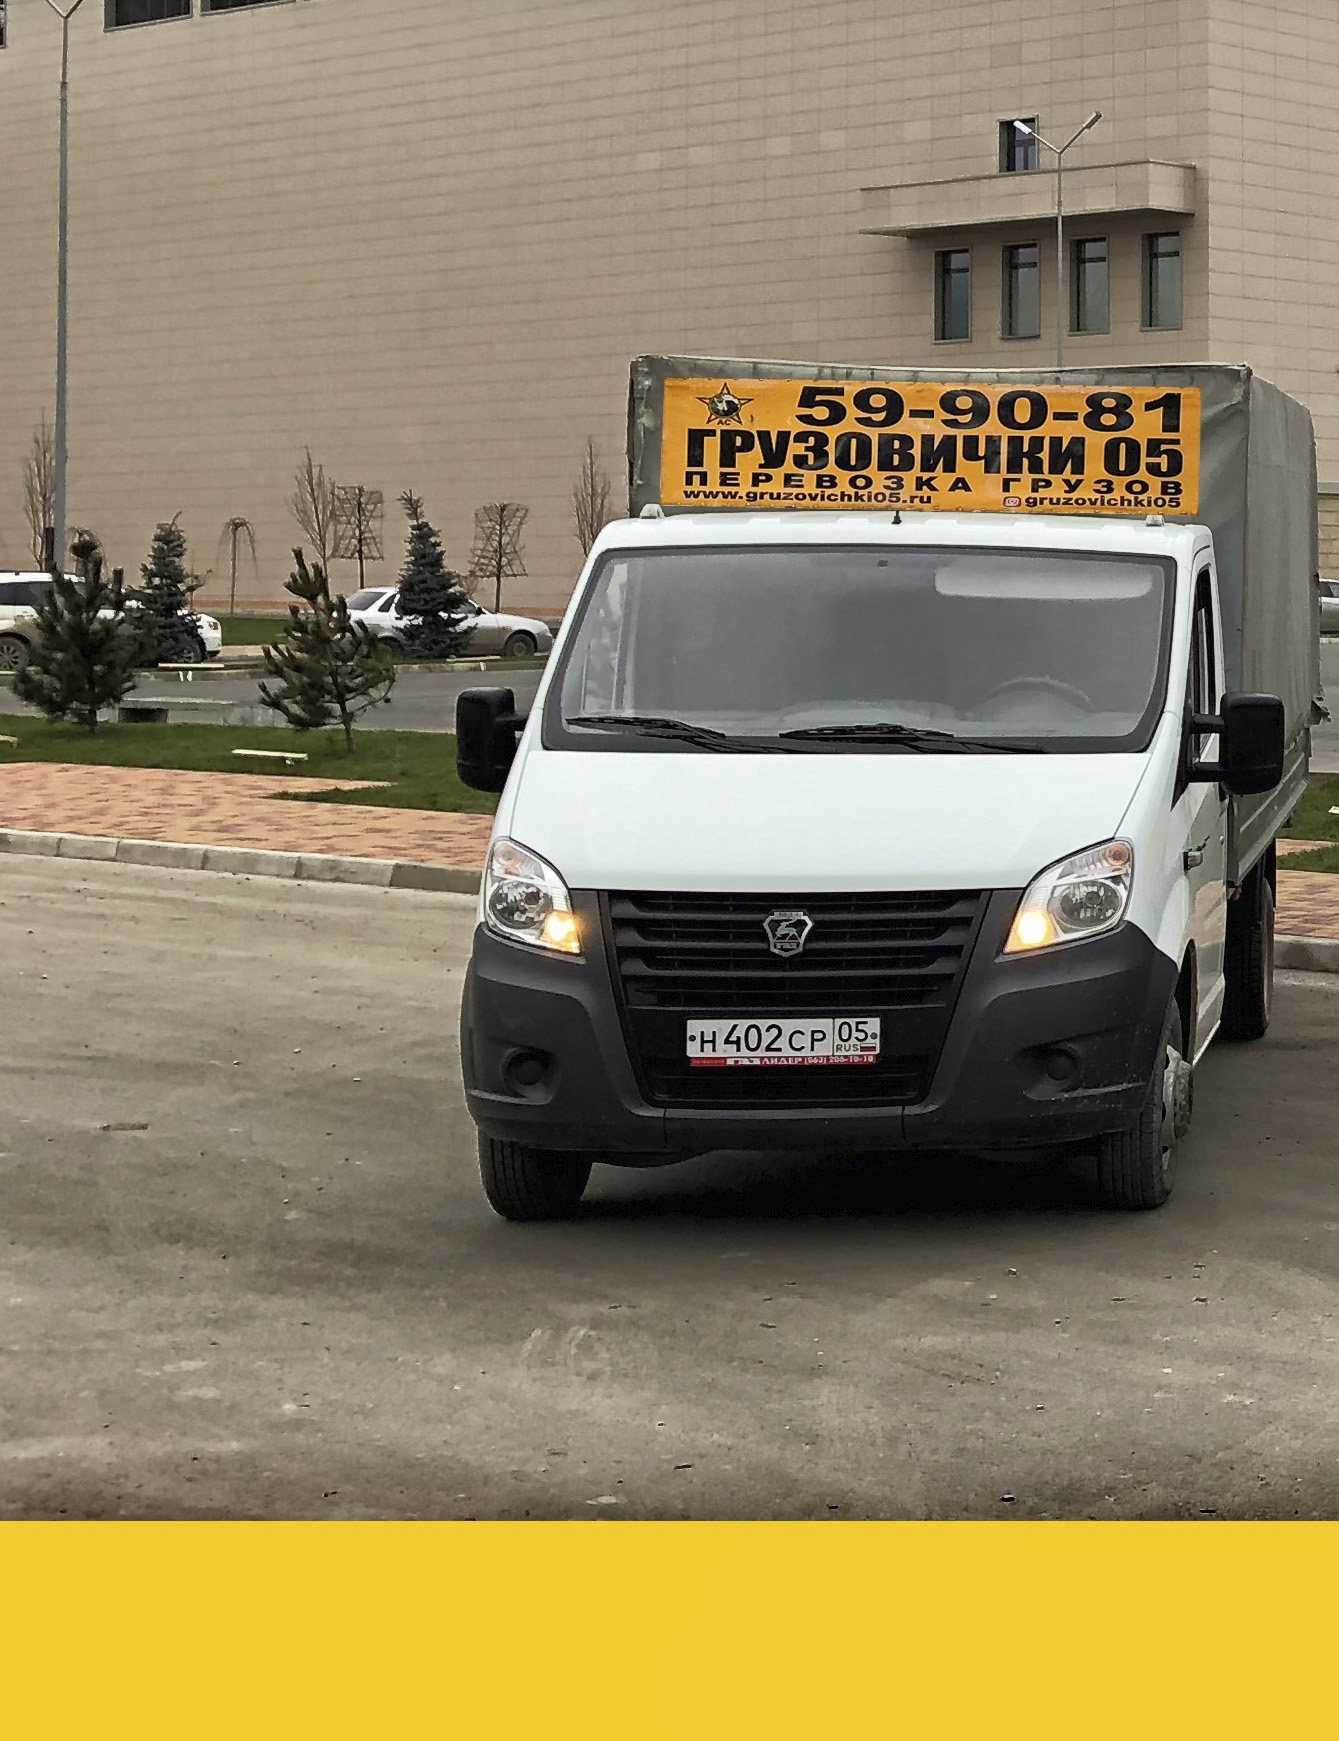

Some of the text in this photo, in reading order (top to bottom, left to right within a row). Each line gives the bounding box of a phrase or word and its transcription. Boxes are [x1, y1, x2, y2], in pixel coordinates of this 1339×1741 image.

[795, 386, 1182, 433] 59-90-81
[687, 428, 1183, 477] ГРУЗОВИЧКИ 05
[685, 471, 1183, 495] ПЕРЕВОЗКА ГРУЗОВ
[683, 490, 1181, 508] www.gruzovichki05.ru gruzovichki05
[700, 1021, 868, 1052] Н402СР 05
[836, 1044, 859, 1052] RUS
